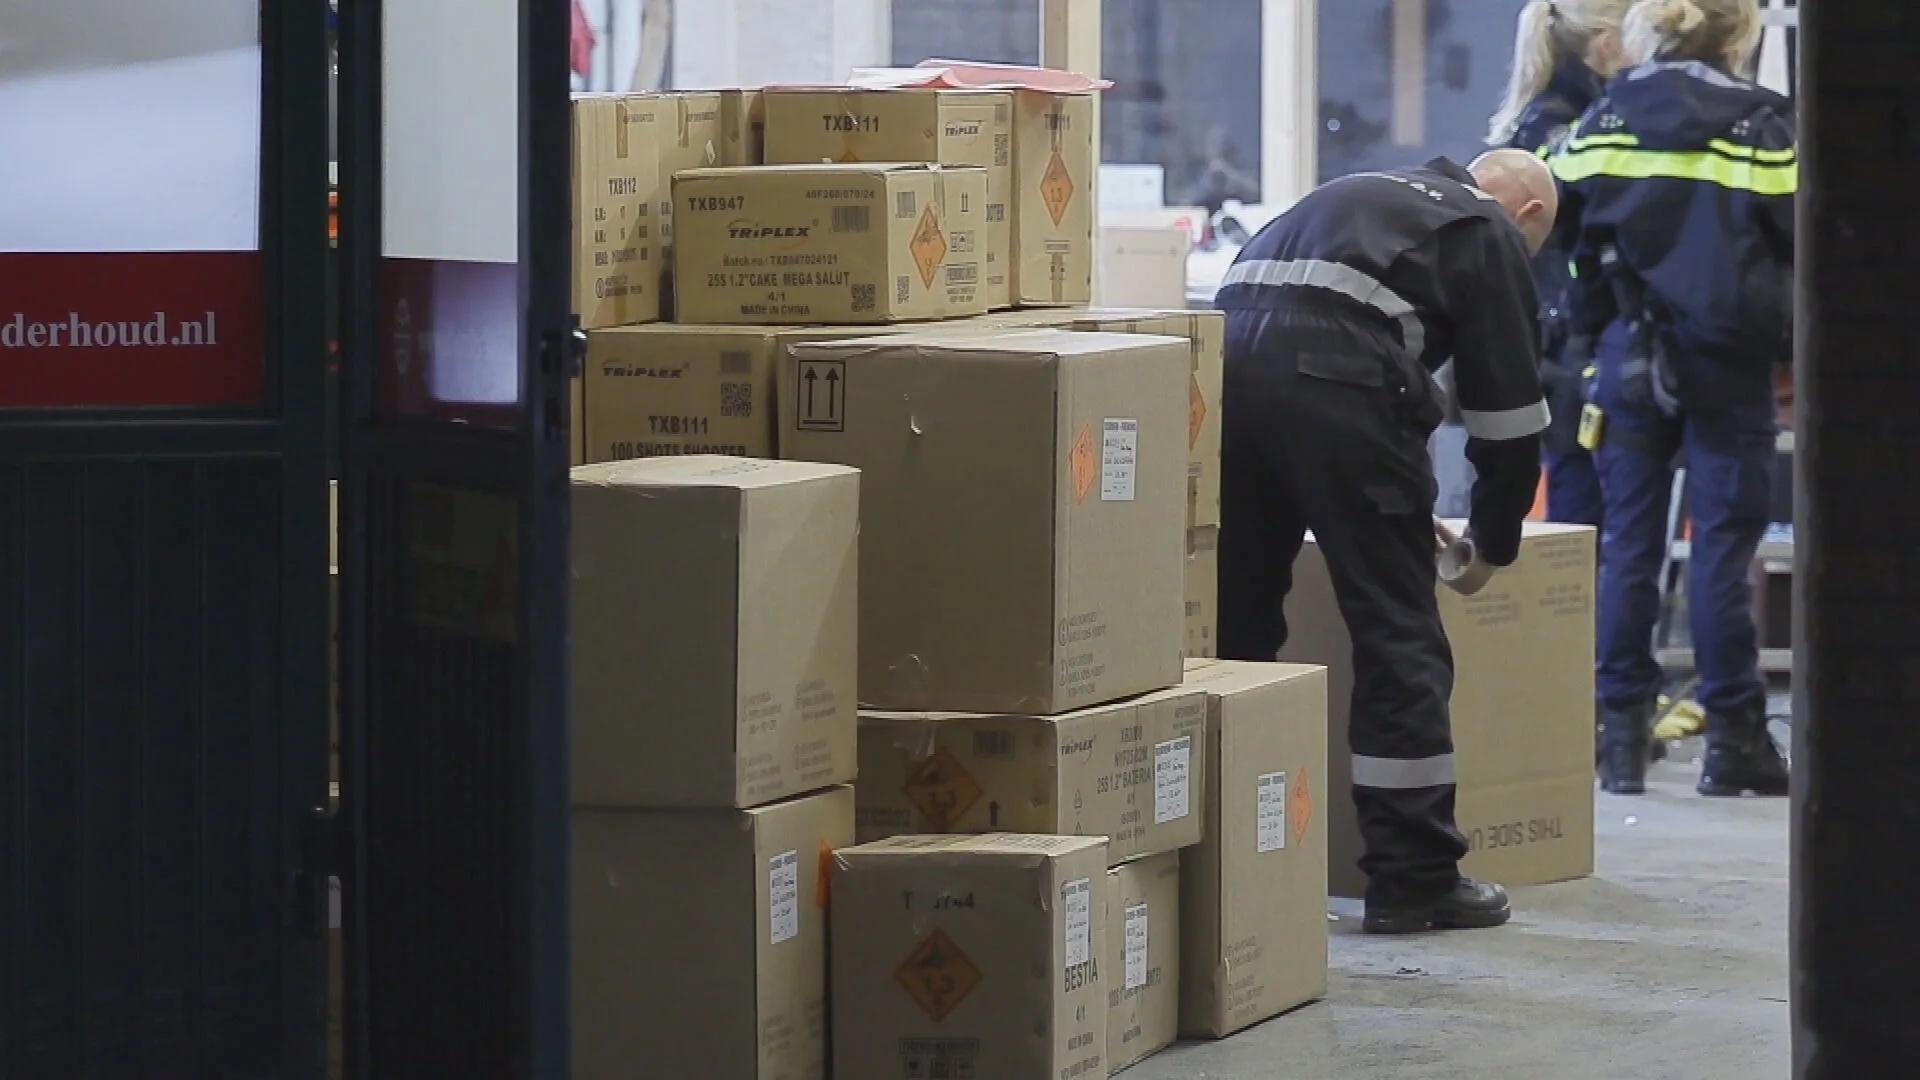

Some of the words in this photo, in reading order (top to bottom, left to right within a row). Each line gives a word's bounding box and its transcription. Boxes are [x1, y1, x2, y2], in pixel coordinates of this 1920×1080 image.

[608, 177, 637, 196] TXB112
[688, 196, 745, 211] TXB947
[723, 255, 749, 267] Batch
[708, 273, 726, 287] 25S
[782, 272, 813, 286] MEGA
[814, 270, 850, 285] SALUT
[741, 304, 767, 316] MADE
[769, 305, 779, 315] IN
[781, 304, 810, 316] CHINA
[0, 311, 217, 347] derhoud.nl
[648, 415, 709, 435] TXB111
[610, 442, 633, 460] 100
[1487, 821, 1525, 849] SIDE
[1528, 816, 1564, 843] THIS
[1064, 957, 1099, 993] BESTIA
